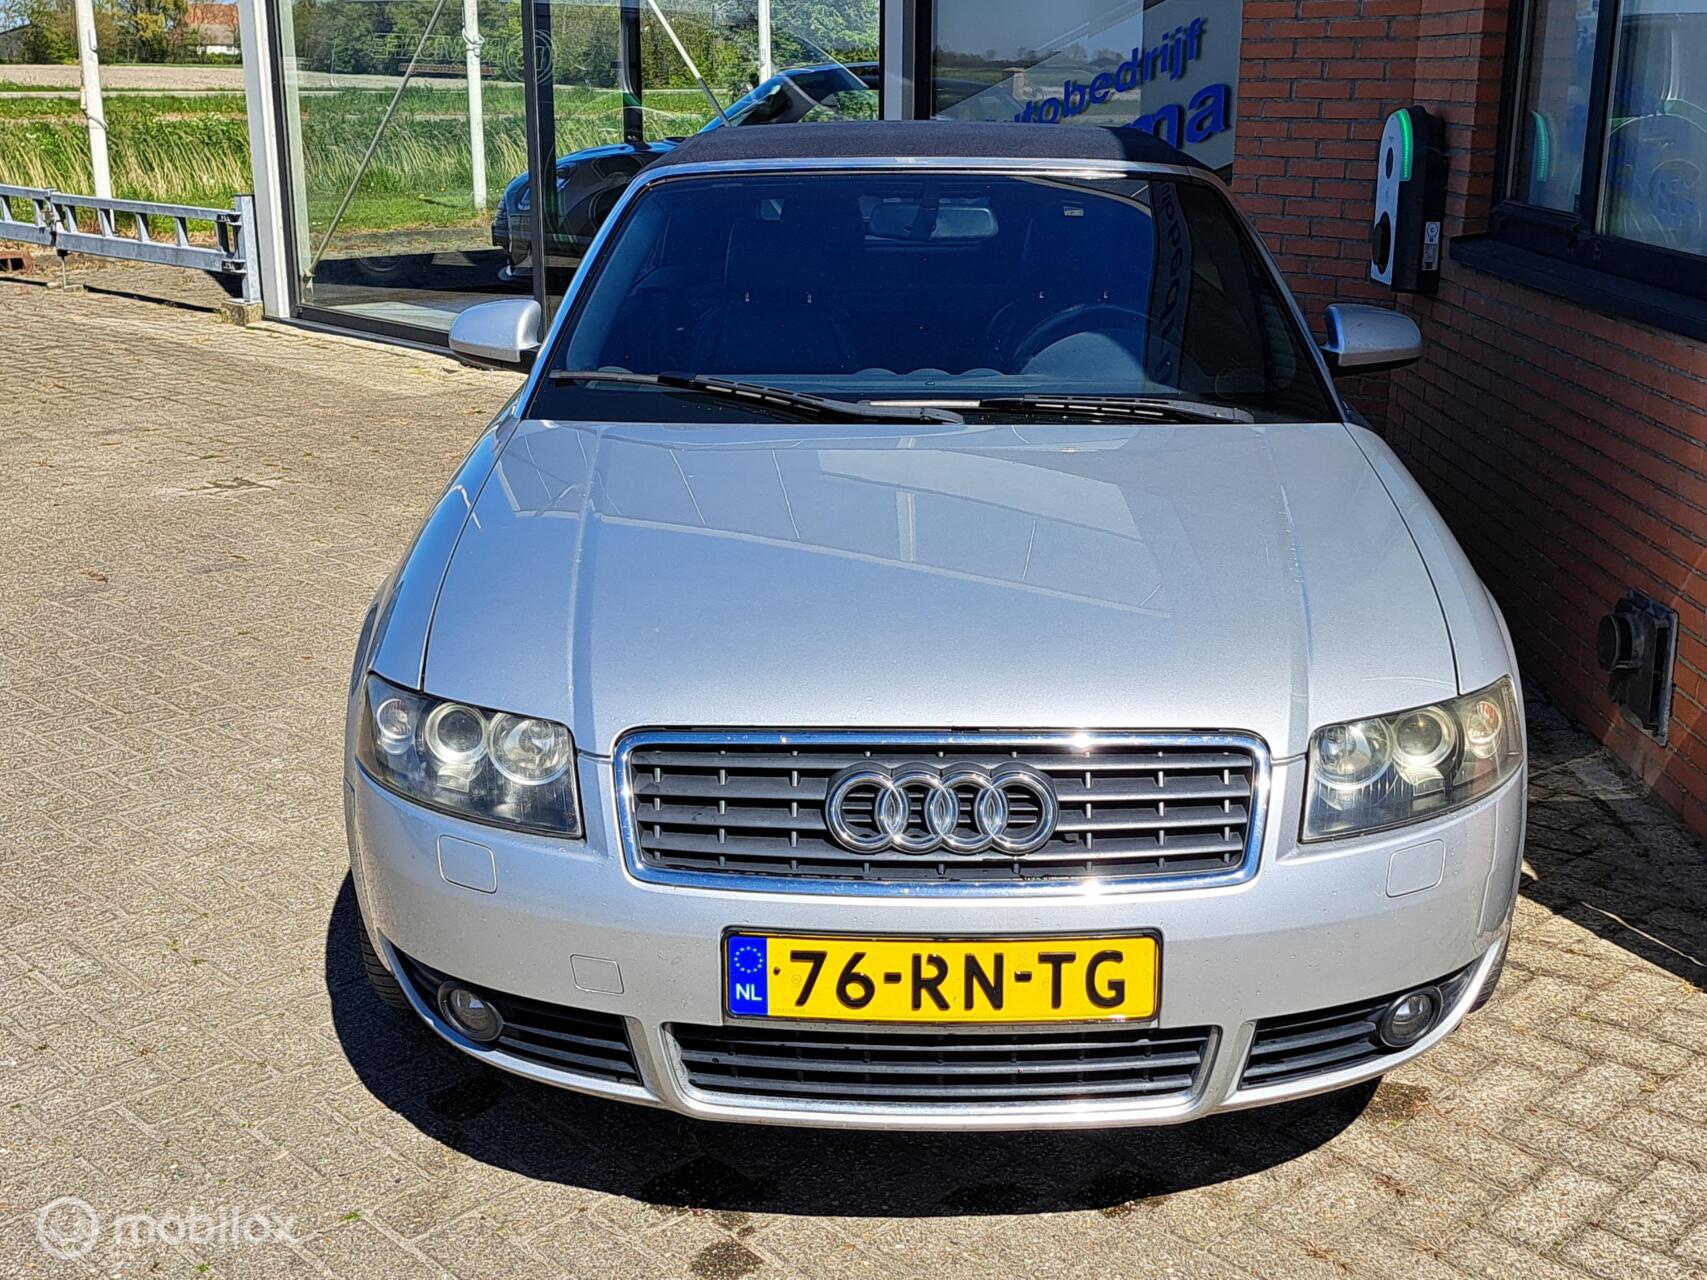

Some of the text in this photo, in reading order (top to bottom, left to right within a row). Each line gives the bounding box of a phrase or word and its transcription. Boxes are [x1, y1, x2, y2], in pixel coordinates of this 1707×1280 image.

[1013, 16, 1206, 123] tobedrijf
[735, 983, 763, 1001] NL
[789, 949, 1126, 1011] 76-RN-TG
